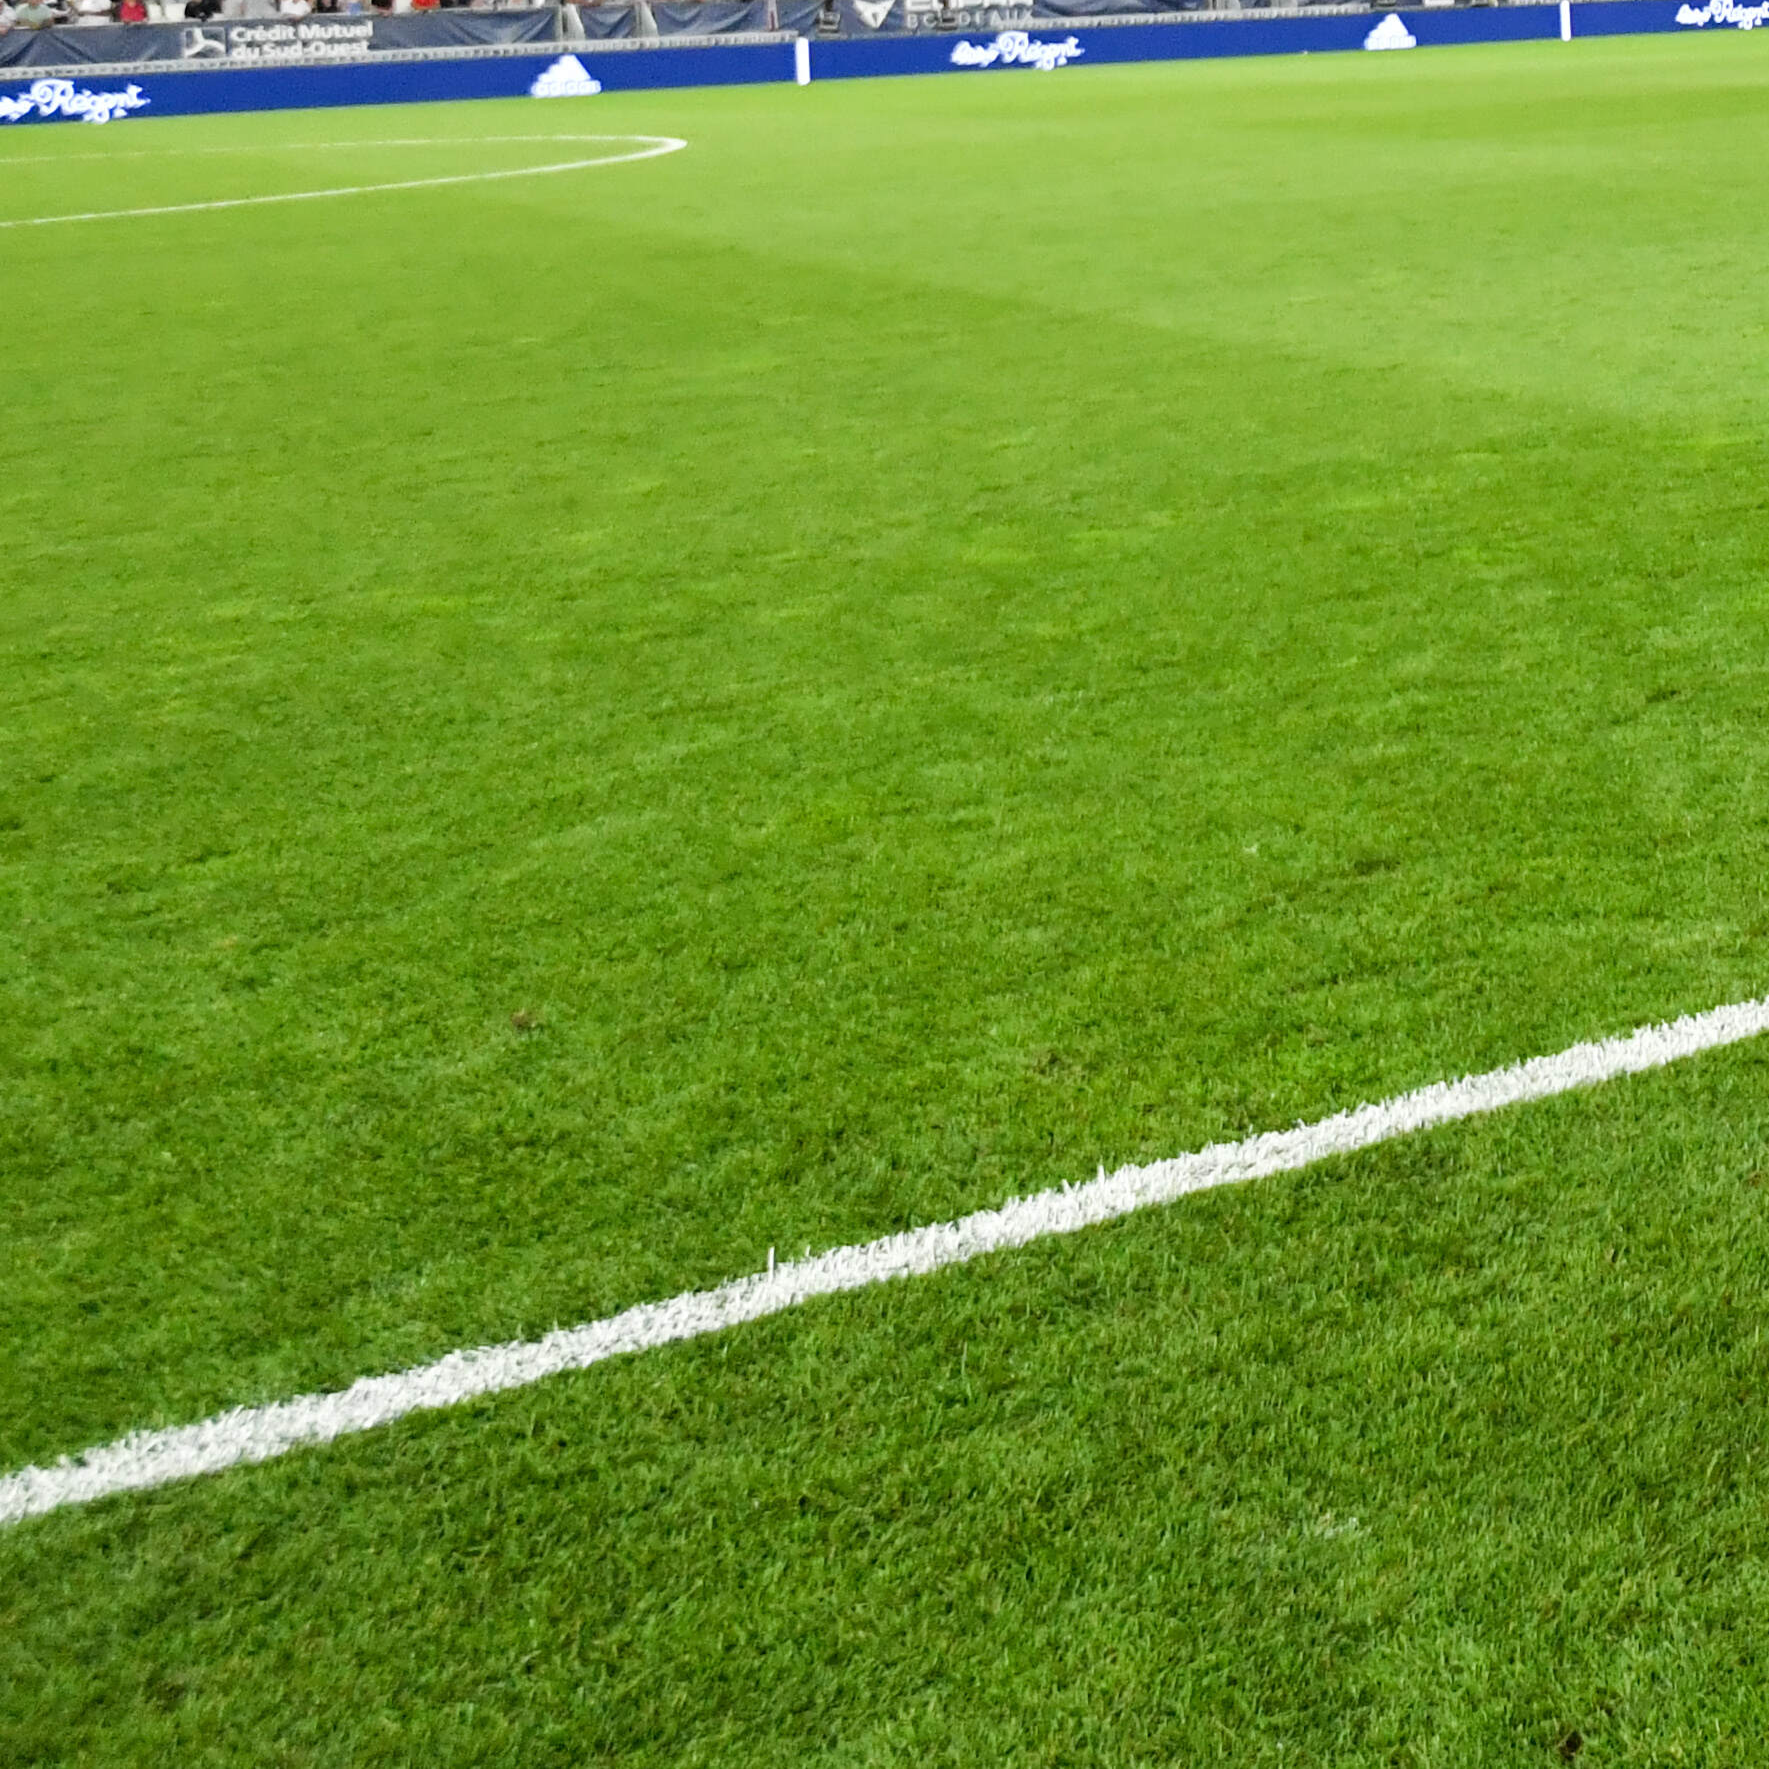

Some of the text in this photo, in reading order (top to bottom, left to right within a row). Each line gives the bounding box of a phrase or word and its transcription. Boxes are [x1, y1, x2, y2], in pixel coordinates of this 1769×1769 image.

[230, 20, 374, 42] Crédit Mutuel
[231, 40, 370, 60] du Sud-Ouest
